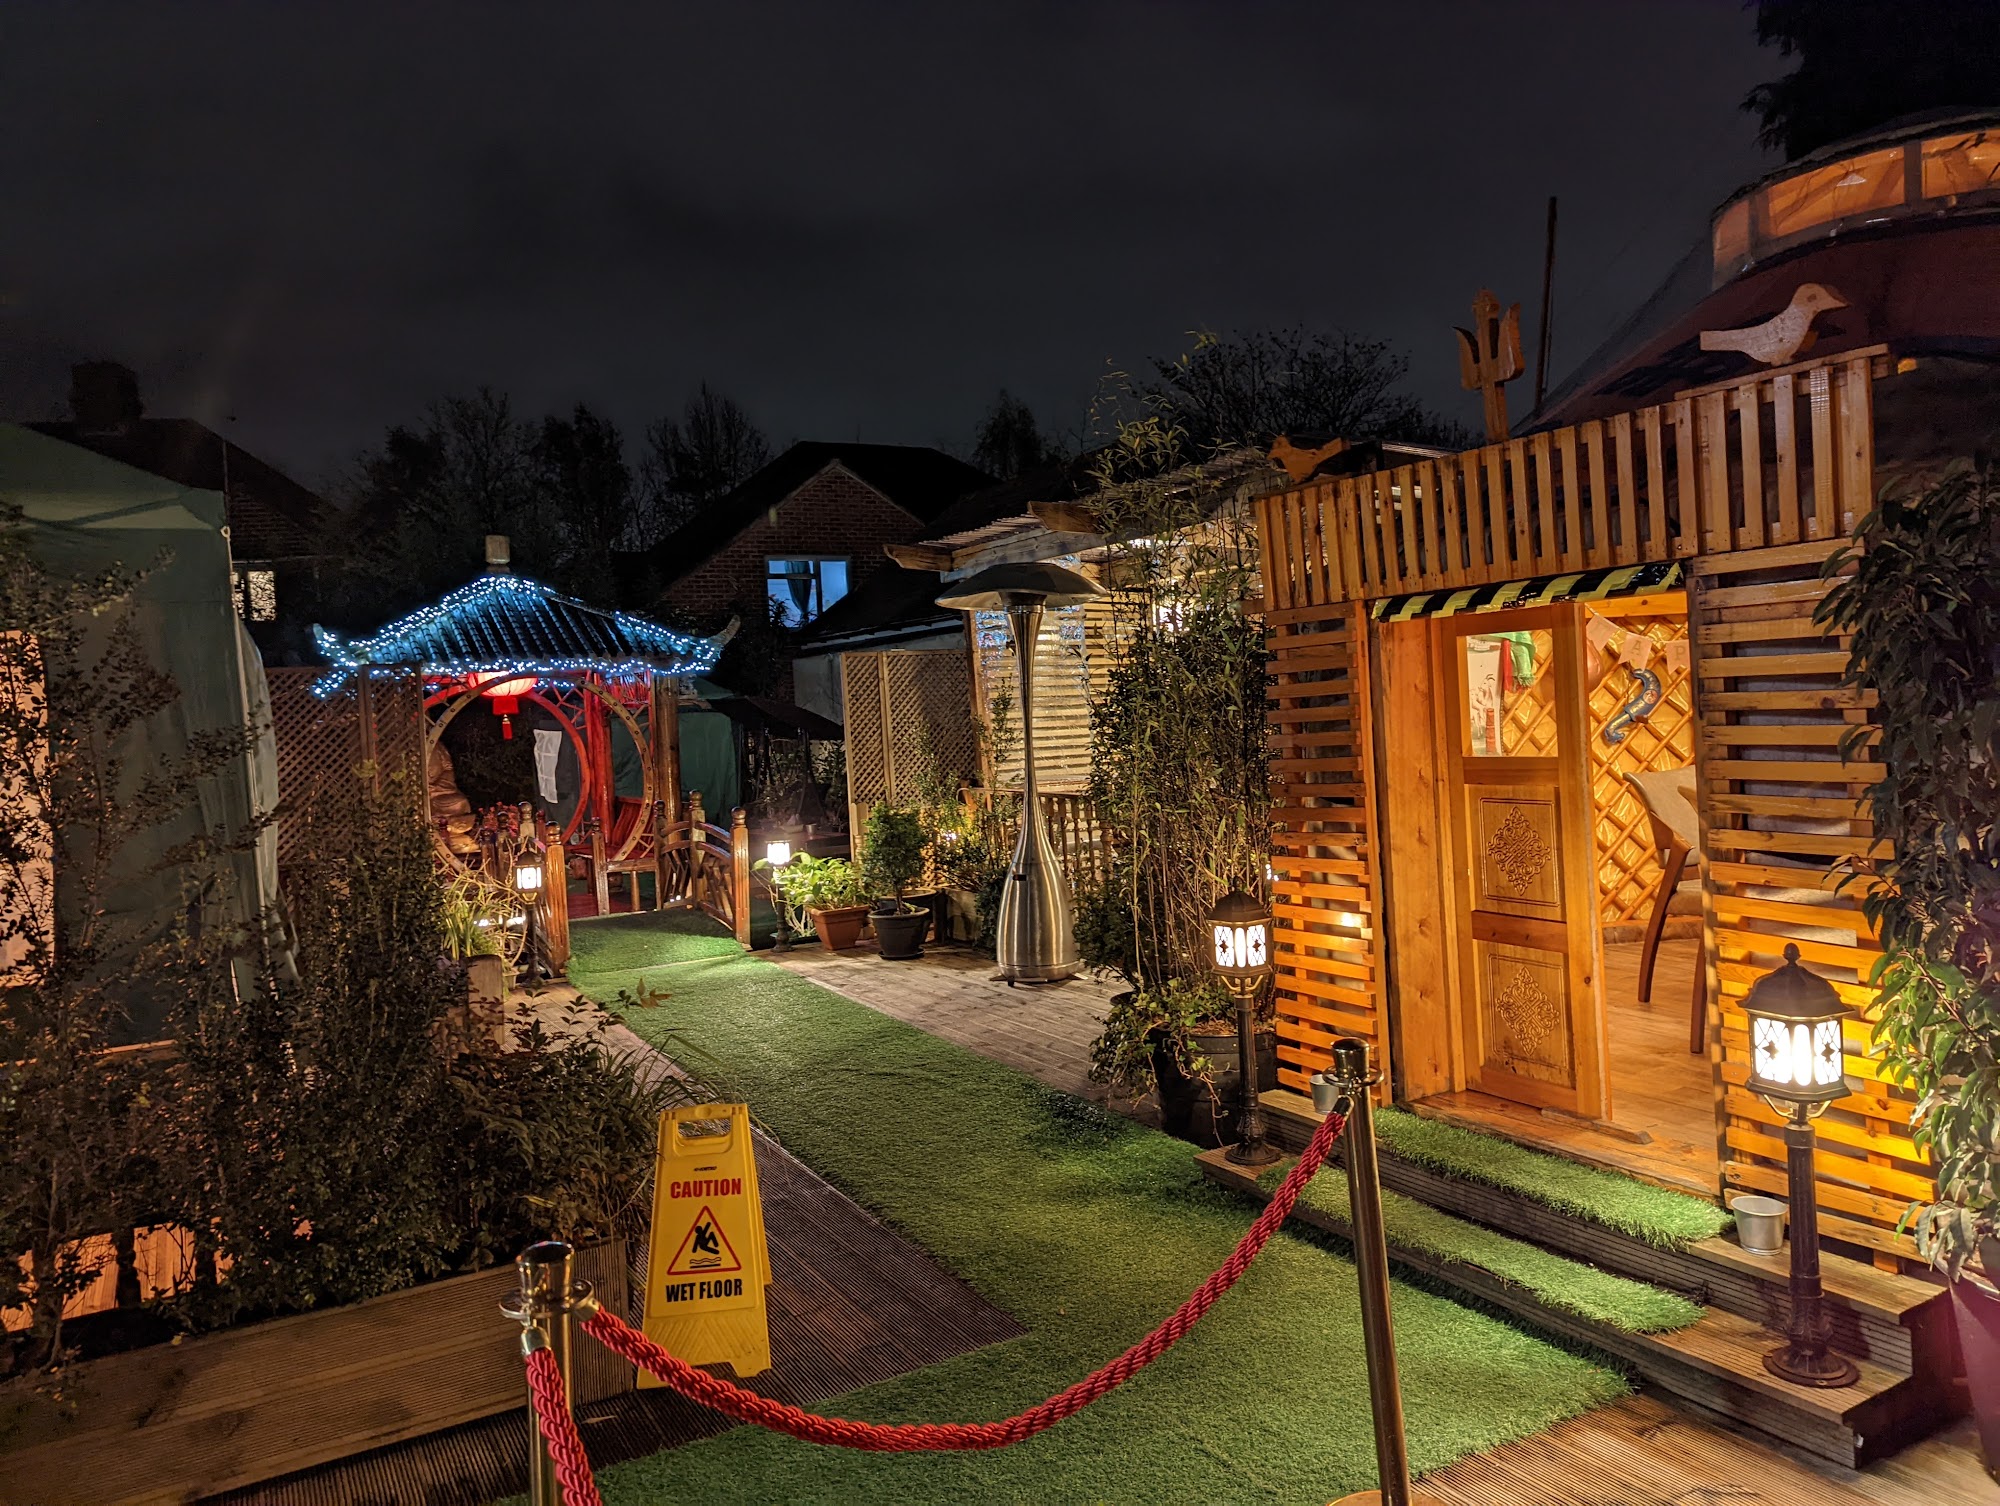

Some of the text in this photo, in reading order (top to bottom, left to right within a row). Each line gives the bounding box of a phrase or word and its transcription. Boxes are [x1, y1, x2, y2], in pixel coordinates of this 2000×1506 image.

[670, 1178, 742, 1199] CAUTION
[665, 1278, 743, 1303] WET FLOOR
